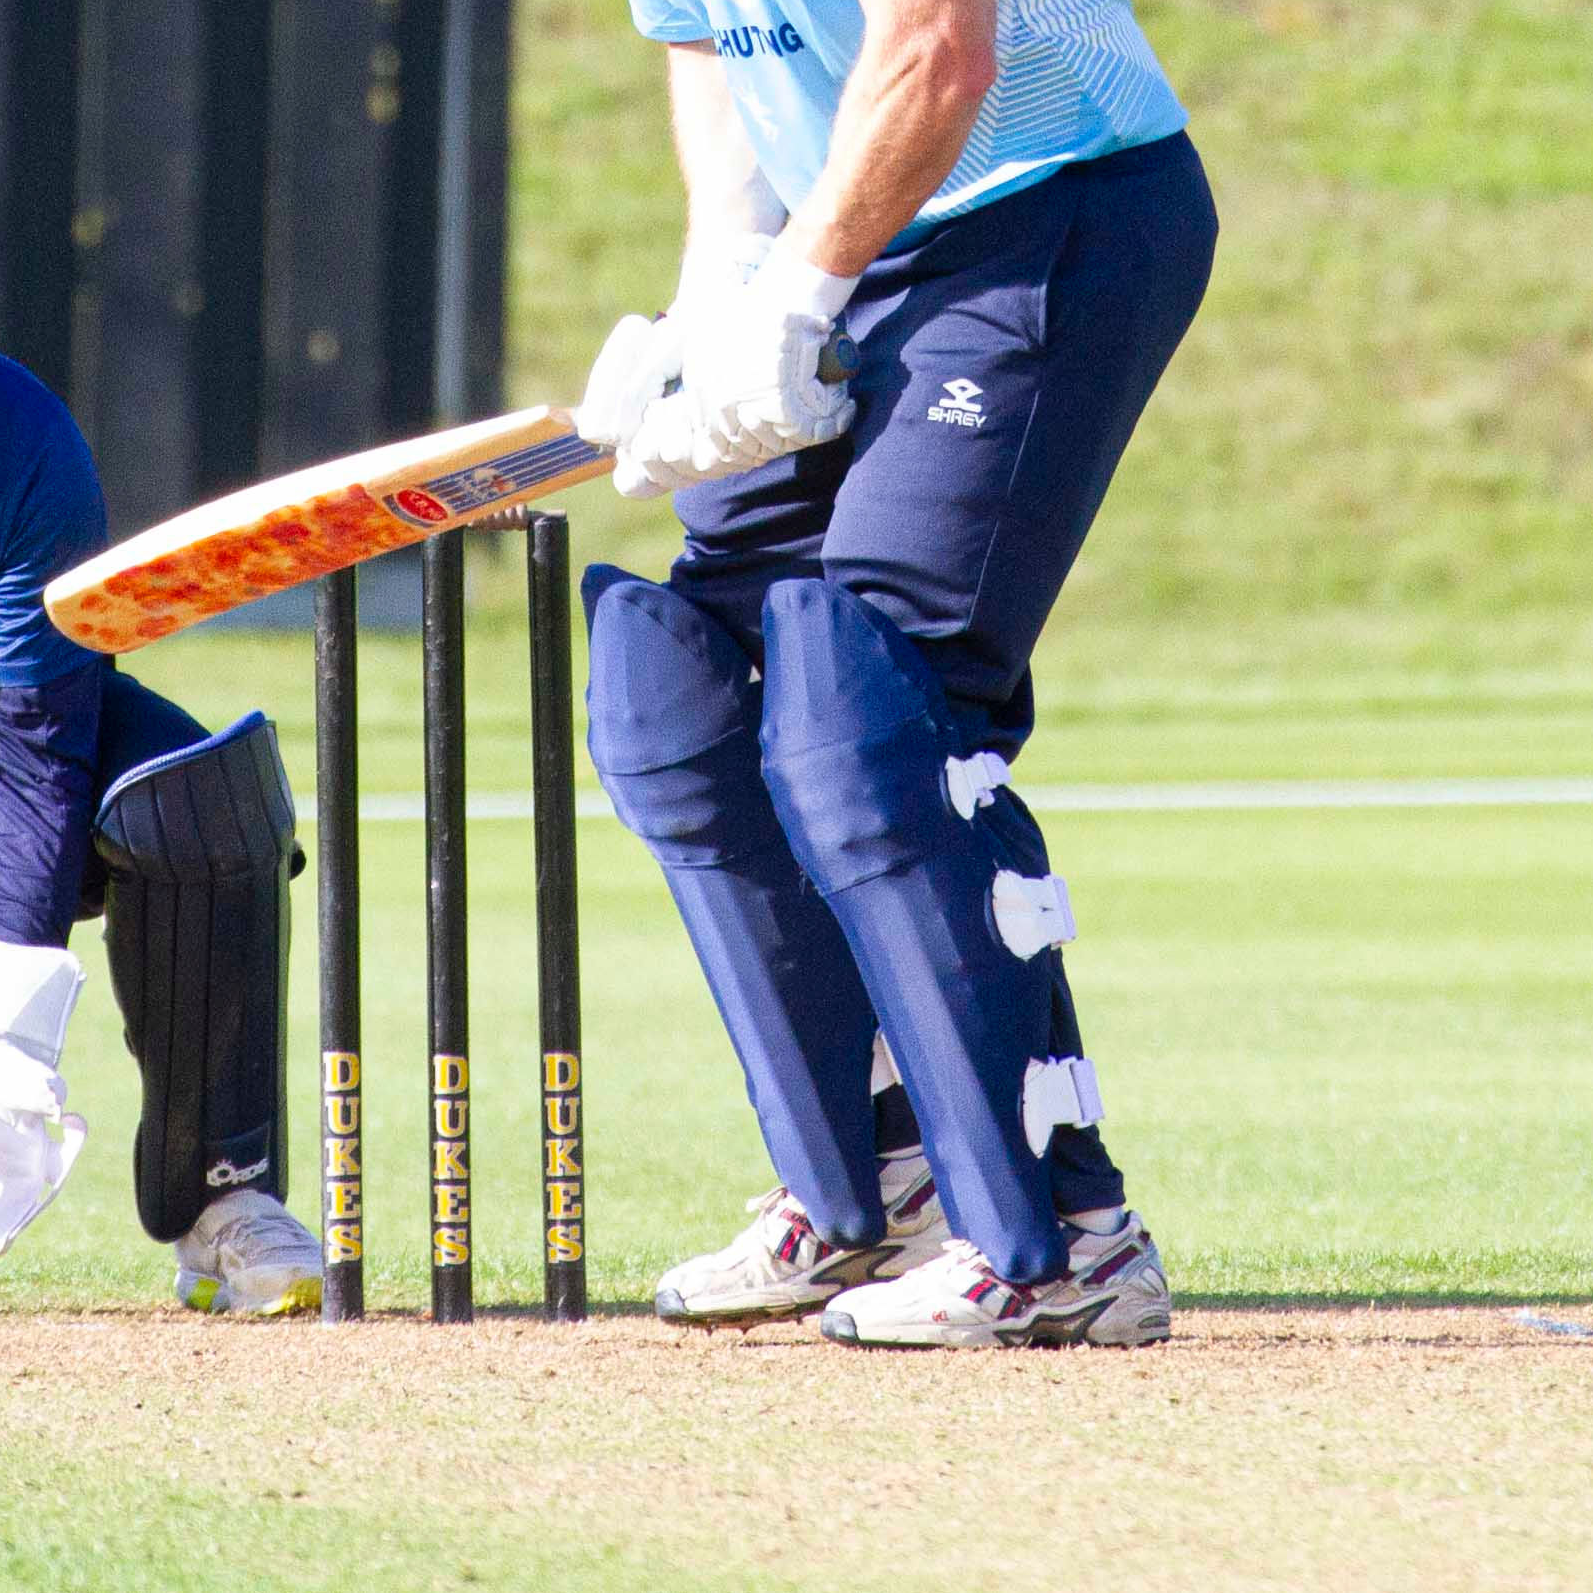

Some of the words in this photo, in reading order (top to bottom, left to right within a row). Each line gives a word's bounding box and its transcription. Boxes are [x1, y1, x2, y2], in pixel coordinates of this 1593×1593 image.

[926, 406, 988, 428] SHREY
[322, 1051, 362, 1264] DUKES
[433, 1054, 470, 1267] DUKES
[543, 1052, 584, 1264] DUKES
